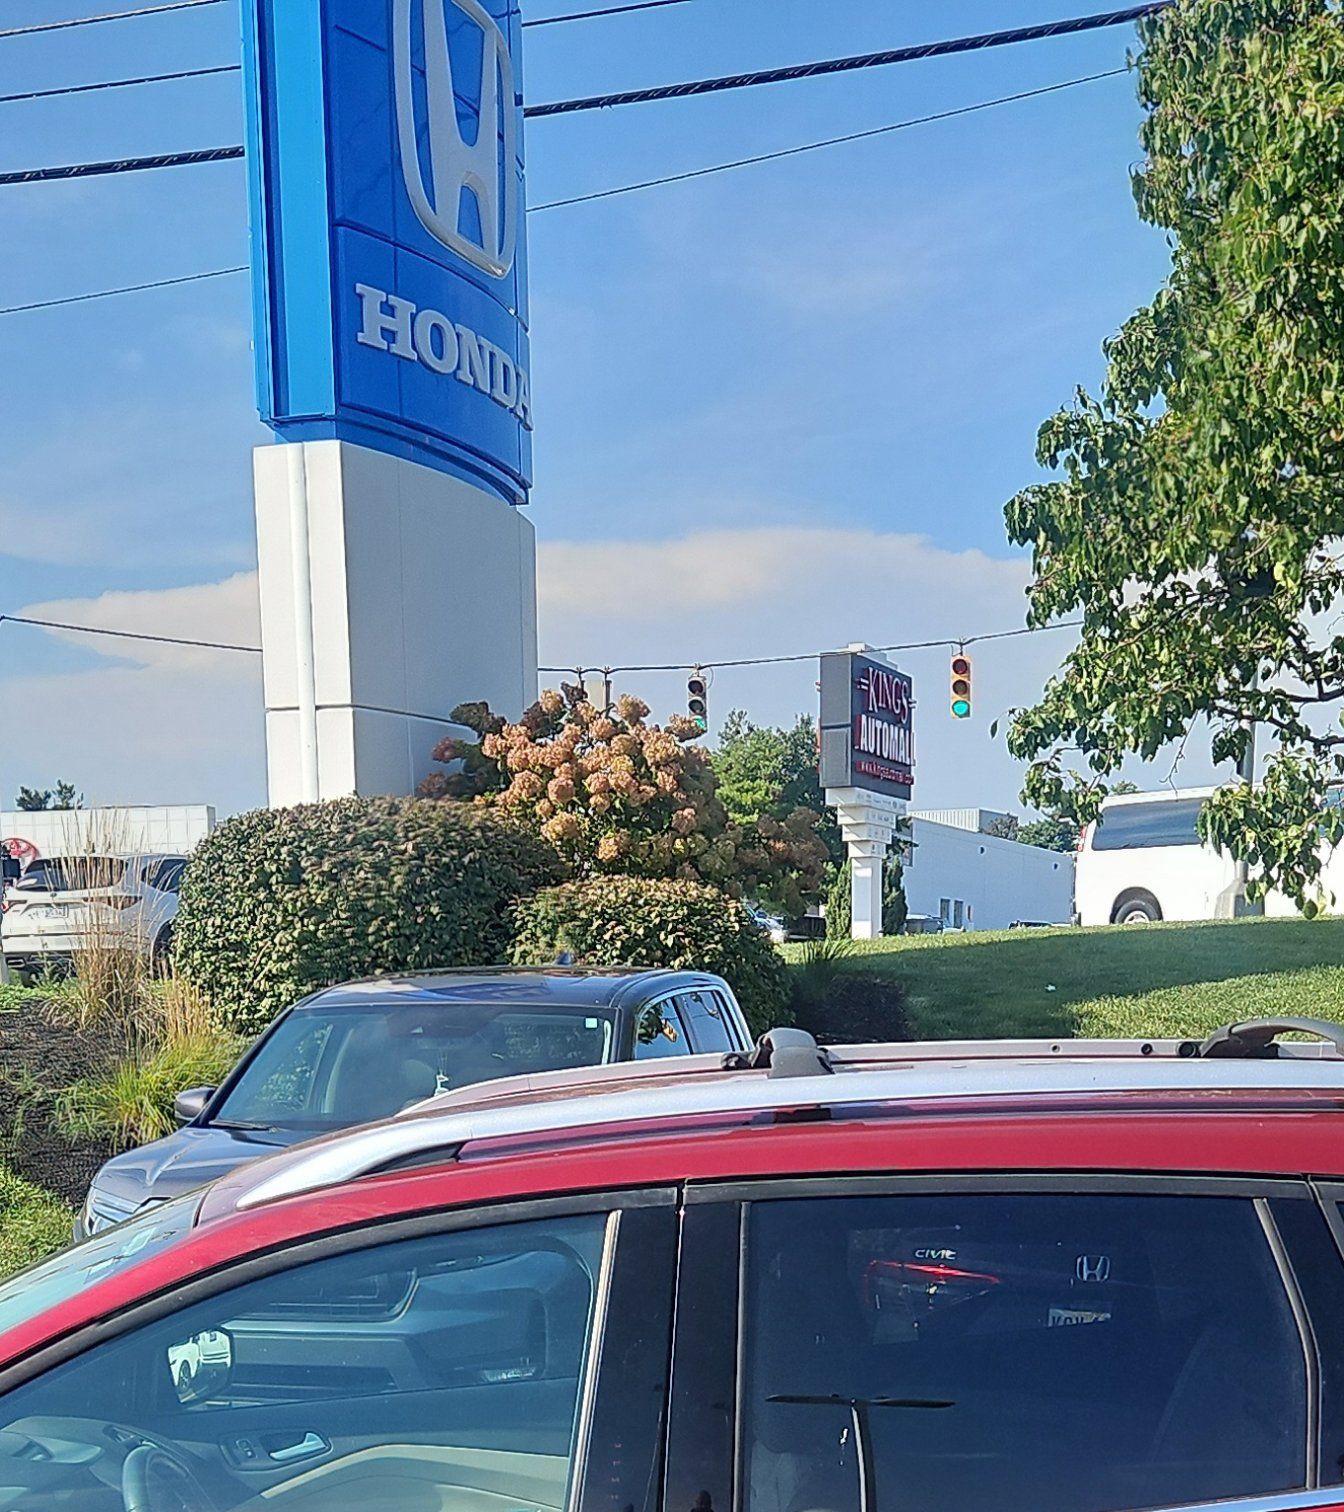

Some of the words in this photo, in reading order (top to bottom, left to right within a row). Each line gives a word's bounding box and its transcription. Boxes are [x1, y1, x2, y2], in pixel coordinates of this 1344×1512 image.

[355, 284, 534, 431] HONDA
[867, 666, 909, 725] KINGS
[859, 713, 916, 766] AUTOMALL
[914, 1249, 957, 1260] CIVIC
